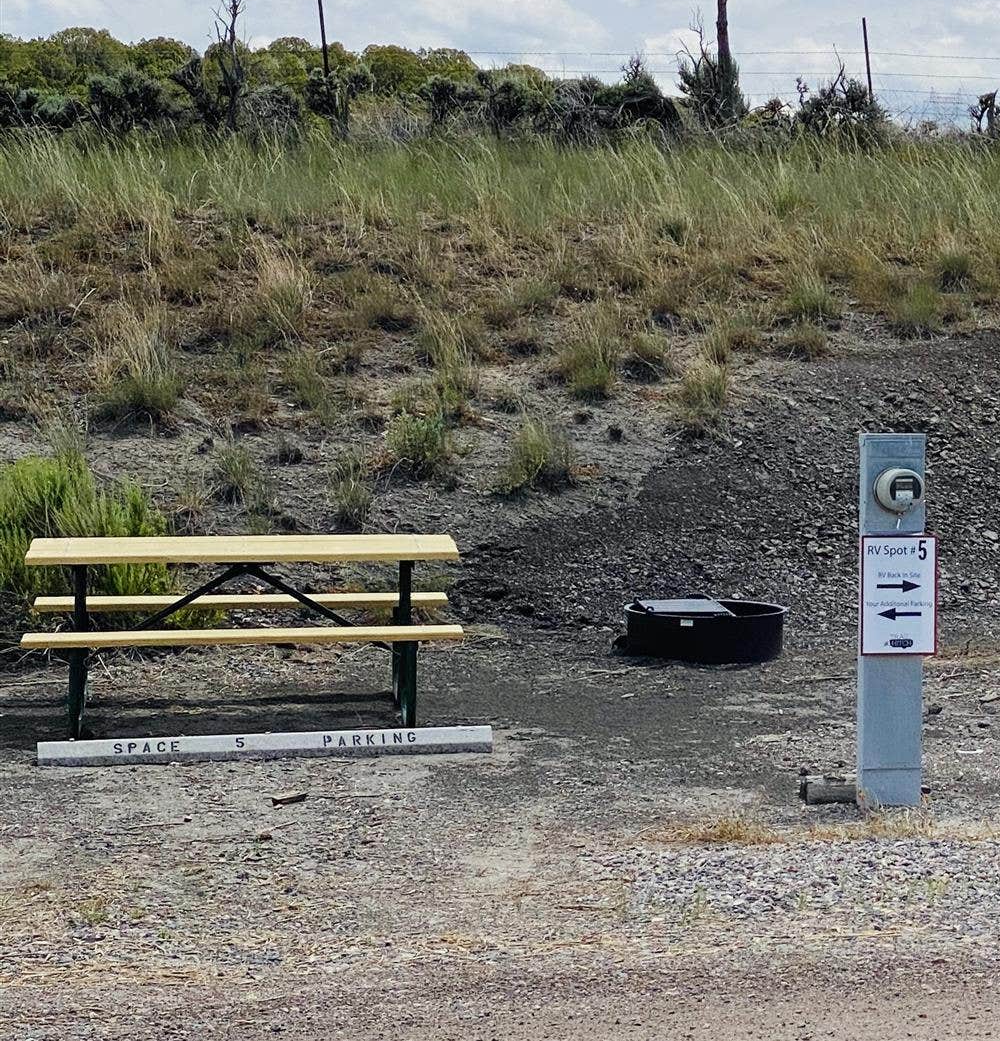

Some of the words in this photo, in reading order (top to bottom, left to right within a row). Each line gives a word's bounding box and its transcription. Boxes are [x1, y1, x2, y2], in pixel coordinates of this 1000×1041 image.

[867, 545, 881, 555] RV
[883, 545, 907, 557] Spot
[113, 741, 181, 754] SPACE
[235, 737, 245, 748] 5
[322, 731, 417, 747] PARKING
